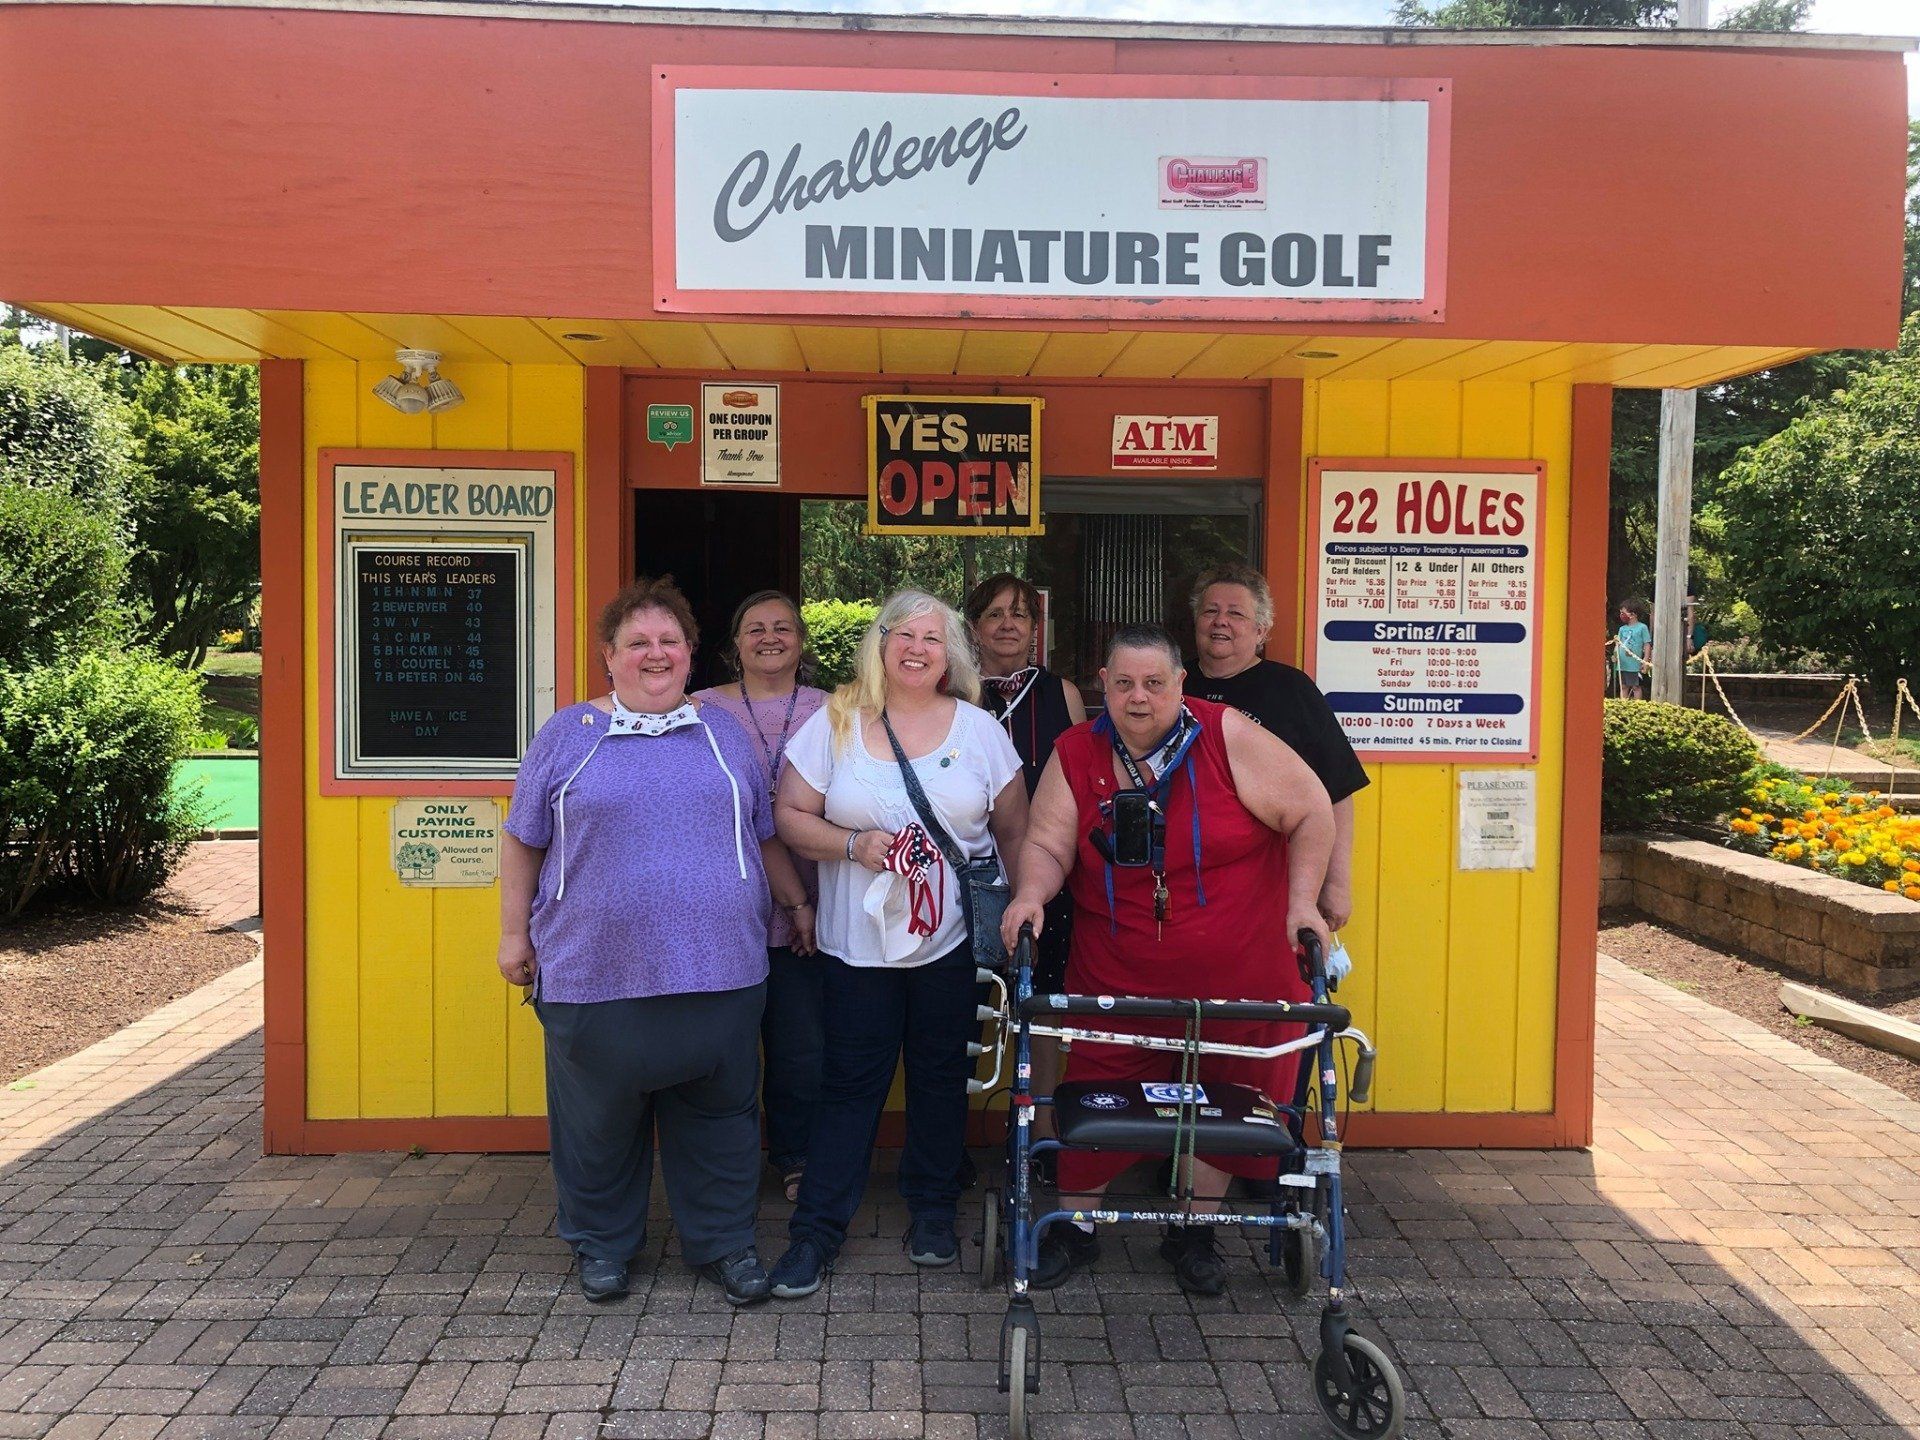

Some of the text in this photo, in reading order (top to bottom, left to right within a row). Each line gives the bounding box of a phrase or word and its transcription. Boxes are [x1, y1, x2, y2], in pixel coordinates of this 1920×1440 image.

[713, 106, 1028, 243] Challenge
[1172, 162, 1254, 189] CHALLENGE
[805, 224, 1391, 288] MINIATURE GOLF
[709, 413, 772, 426] ONE COUPON
[713, 429, 768, 441] PER GROUP
[879, 413, 1029, 453] YES WE'RE
[1119, 420, 1207, 452] ATM
[717, 448, 764, 461] Thank You
[1132, 457, 1192, 465] AVAILABLE INSIDE
[879, 460, 1029, 517] OPEN
[343, 481, 553, 517] LEADER BOARD
[1333, 479, 1525, 537] 22 HOLES
[1334, 544, 1520, 556] Prices subject to Derry Township Amusement Tax
[375, 555, 420, 566] COURSE
[427, 555, 471, 567] RECORD
[1326, 557, 1387, 567] Family Discount
[1331, 567, 1381, 576] Card Holders
[1396, 562, 1459, 573] 12 & Under
[1471, 563, 1525, 574] All Others
[362, 570, 496, 584] THIS YEAR'S LEADERS
[1326, 577, 1338, 586] Our
[1339, 577, 1356, 586] Price
[1397, 579, 1408, 587] Our
[1410, 579, 1427, 587] Price
[1468, 579, 1480, 588] Our
[1481, 579, 1498, 588] Price
[467, 589, 482, 599] 37
[1397, 588, 1408, 597] Tax
[372, 602, 380, 612] 2
[466, 602, 482, 612] 40
[1326, 597, 1385, 609] Total $7.00
[1397, 598, 1456, 610] Total $7.50
[1468, 599, 1527, 611] Total $9.00
[372, 617, 380, 627] 3
[465, 617, 481, 628] 43
[1374, 622, 1477, 641] Spring/Fall
[372, 632, 380, 642] 4
[467, 632, 482, 643] 44
[373, 646, 380, 656] 5
[465, 646, 480, 656] 45
[1372, 647, 1477, 656] Wed-Thurs 10:00-9:00
[374, 659, 382, 669] 6
[468, 659, 484, 669] 45
[1390, 658, 1480, 667] Fri 10:00-10:00
[374, 673, 382, 682] 7
[468, 673, 484, 683] 46
[1377, 668, 1481, 678] Saturday 10:00-10:00
[1381, 679, 1478, 689] Sunday 10:00-8:00
[1384, 694, 1464, 712] Summer
[389, 711, 422, 722] HAVE
[1341, 716, 1506, 730] 10:00-10:00 7 Days a Week
[415, 726, 440, 737] DAY
[1374, 736, 1414, 745] Admitted
[1419, 736, 1431, 746] 45
[1433, 736, 1453, 746] min.
[1455, 736, 1478, 747] Prior
[1479, 737, 1488, 747] to
[1491, 737, 1523, 748] Closing
[1467, 781, 1500, 791] PLEASE
[424, 804, 468, 814] ONLY
[416, 817, 476, 827] PAYING
[398, 829, 495, 839] CUSTOMERS
[441, 846, 479, 854] Allowed
[450, 856, 484, 864] Course.
